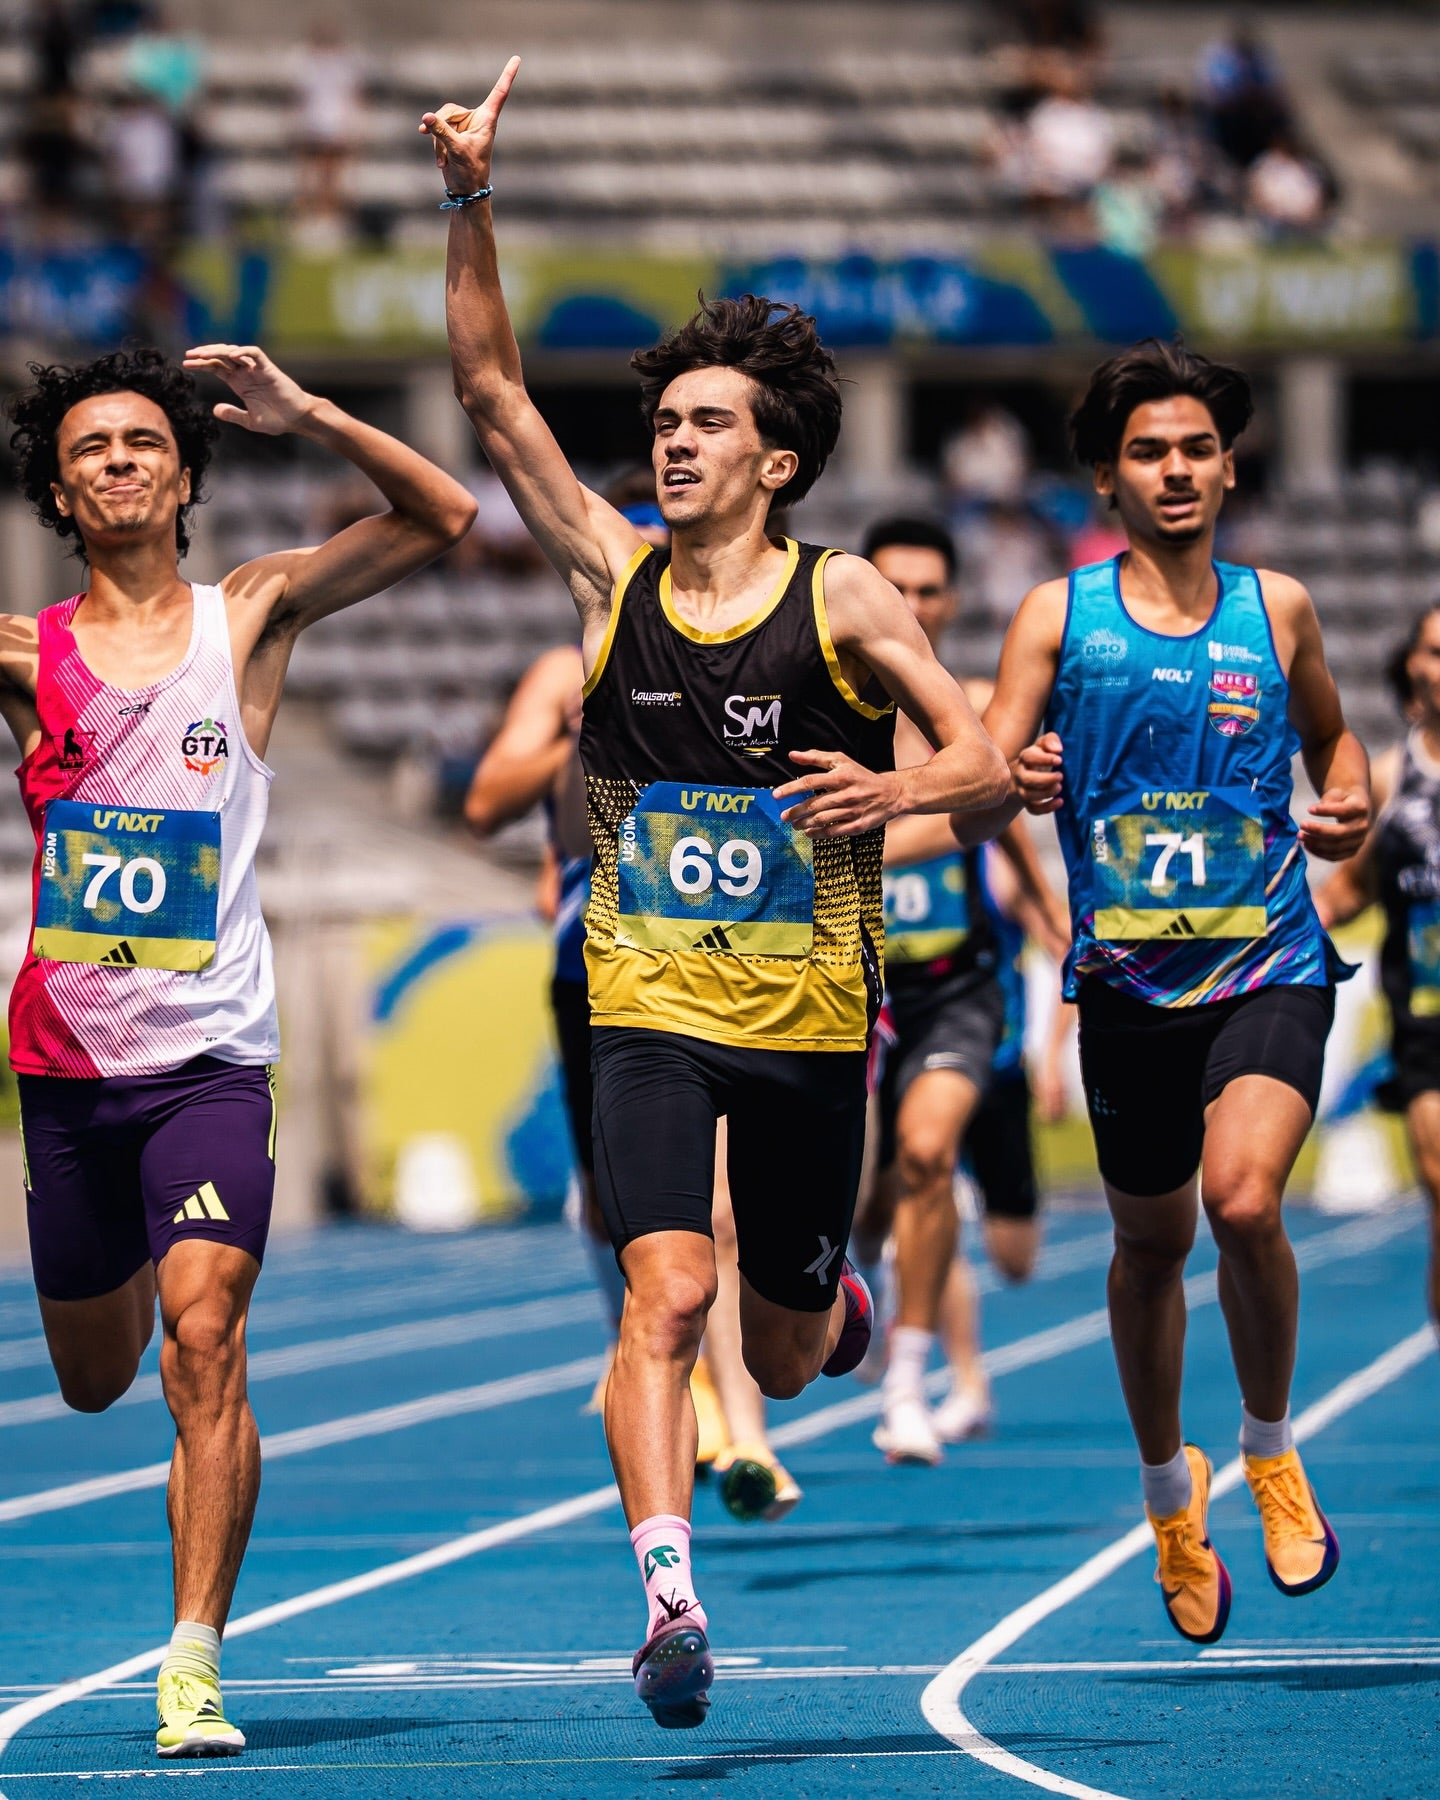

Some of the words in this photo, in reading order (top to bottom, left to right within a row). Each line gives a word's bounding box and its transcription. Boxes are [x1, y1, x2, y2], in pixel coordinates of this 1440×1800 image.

[181, 736, 229, 758] GTA
[81, 852, 167, 914] 70
[669, 836, 763, 897] 69
[1145, 832, 1206, 887] 71
